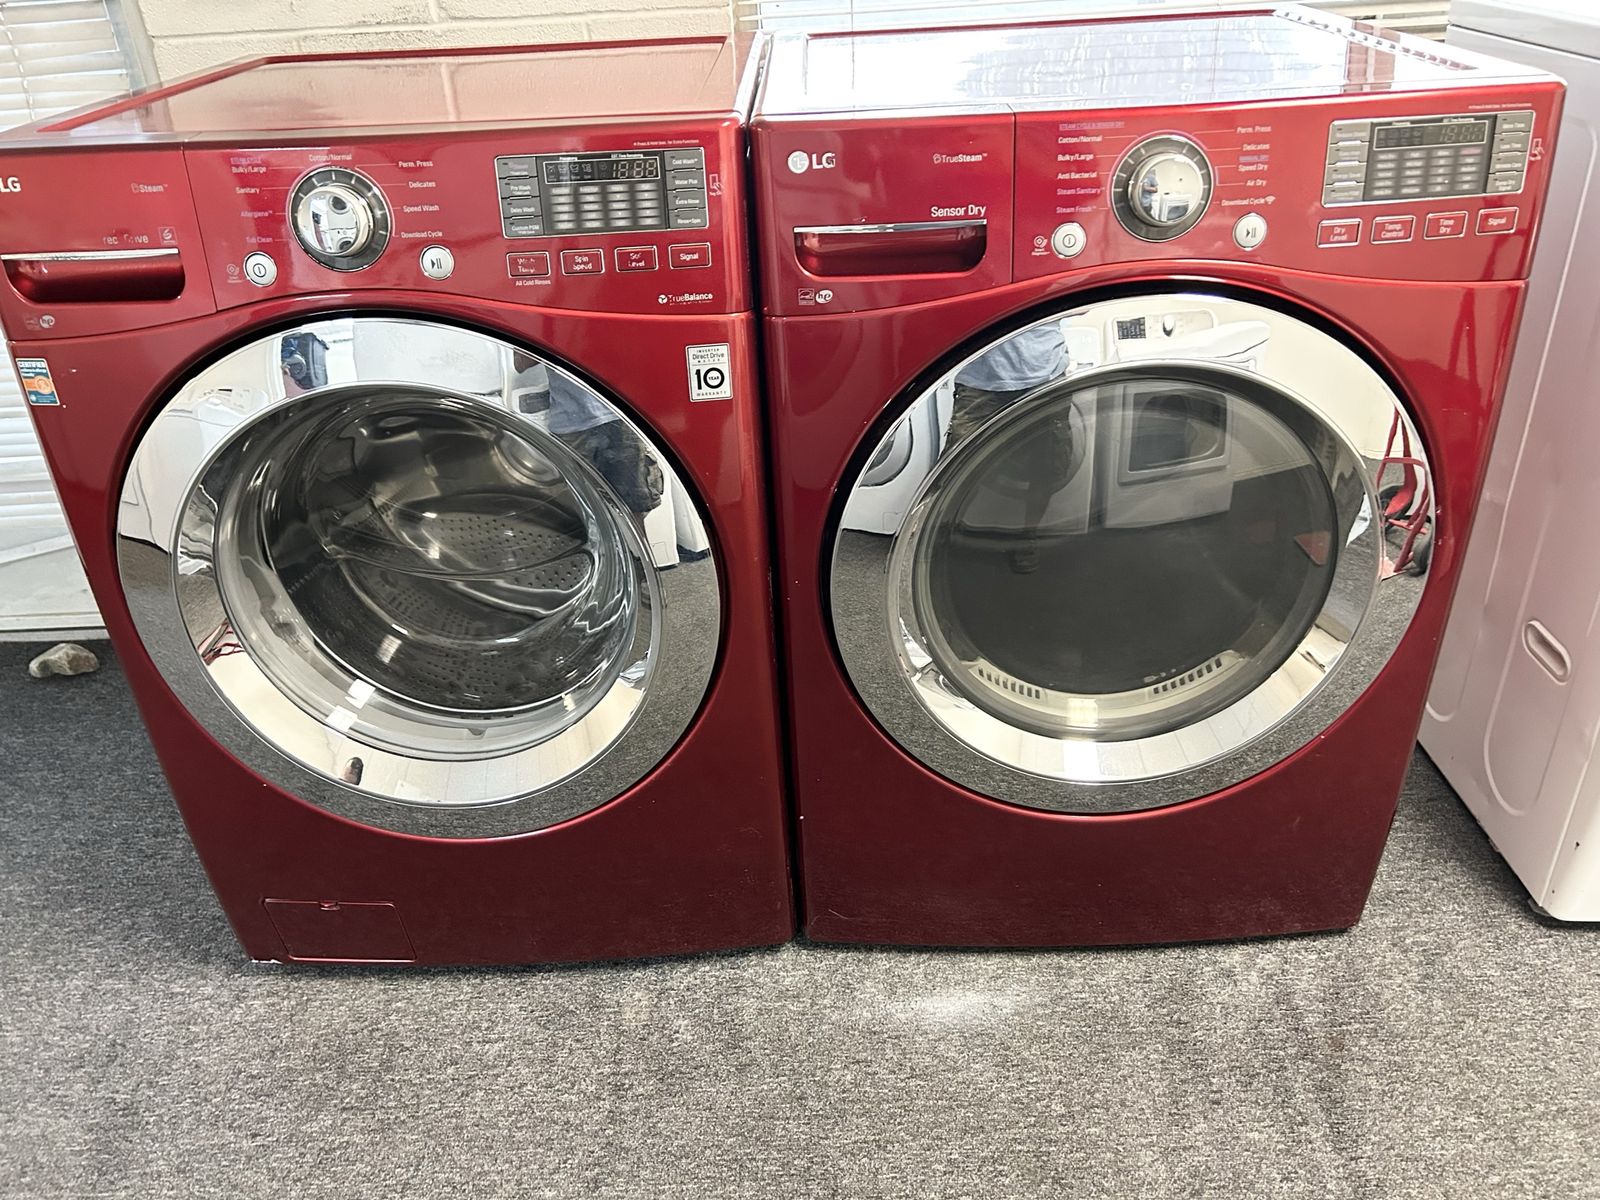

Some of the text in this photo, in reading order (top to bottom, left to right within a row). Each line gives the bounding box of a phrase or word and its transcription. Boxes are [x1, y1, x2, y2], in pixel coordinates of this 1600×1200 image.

[1254, 125, 1272, 133] Press
[1057, 135, 1103, 144] Cotton/Normal
[1242, 144, 1271, 152] Delicates
[308, 154, 353, 163] Cotton/Normal
[811, 152, 836, 169] LG
[1057, 153, 1094, 162] Bulky/Large
[416, 160, 434, 168] Press
[1257, 163, 1268, 171] Dry
[231, 165, 267, 174] Bulky/Large
[1057, 171, 1098, 180] Anti Bacterial
[408, 181, 436, 189] Delicates
[1255, 179, 1267, 187] Dry
[235, 187, 261, 195] Sanitary
[1249, 198, 1265, 206] Cycle
[402, 204, 440, 214] Speed Wash
[930, 204, 987, 218] Sensor Dry
[1487, 217, 1507, 226] Signal
[401, 230, 443, 239] Download Cycle
[1439, 226, 1452, 234] Dry
[574, 255, 589, 264] Spin
[679, 252, 699, 262] Signal
[692, 353, 709, 361] Direct
[695, 367, 725, 390] 10
